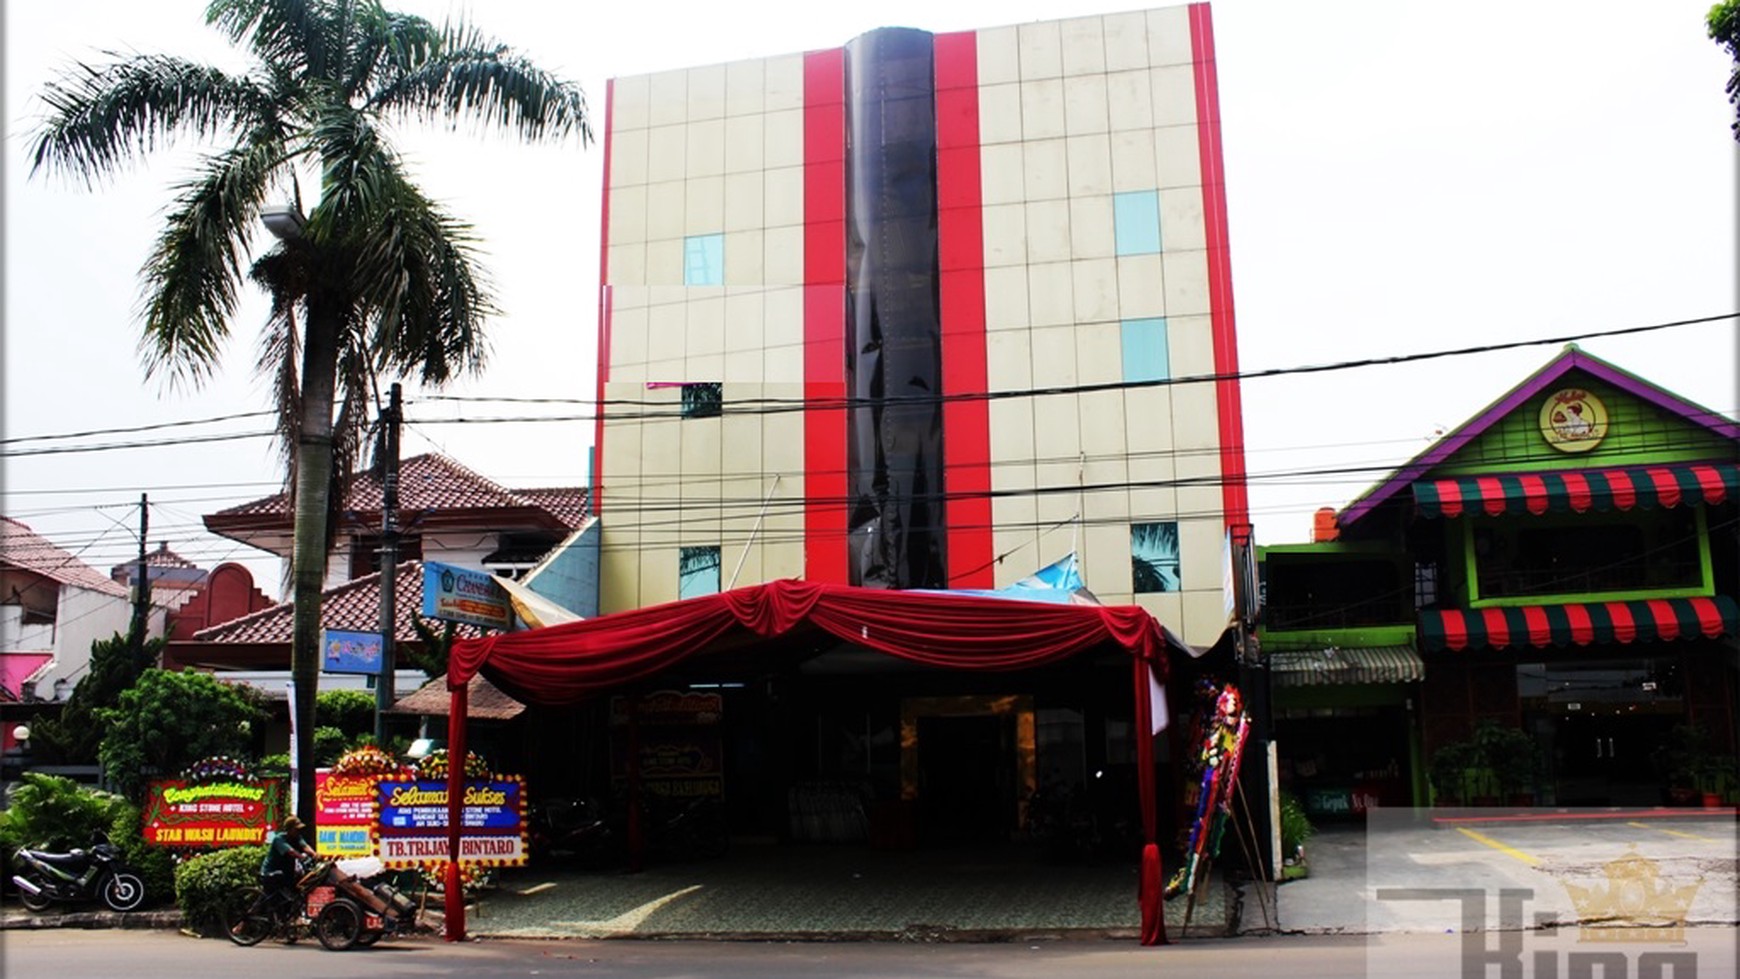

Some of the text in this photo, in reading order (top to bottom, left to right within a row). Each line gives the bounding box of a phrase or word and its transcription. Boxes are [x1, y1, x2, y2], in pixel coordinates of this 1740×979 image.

[156, 828, 264, 842] STAR WASH LAUNDRY
[462, 839, 514, 855] BINTARO
